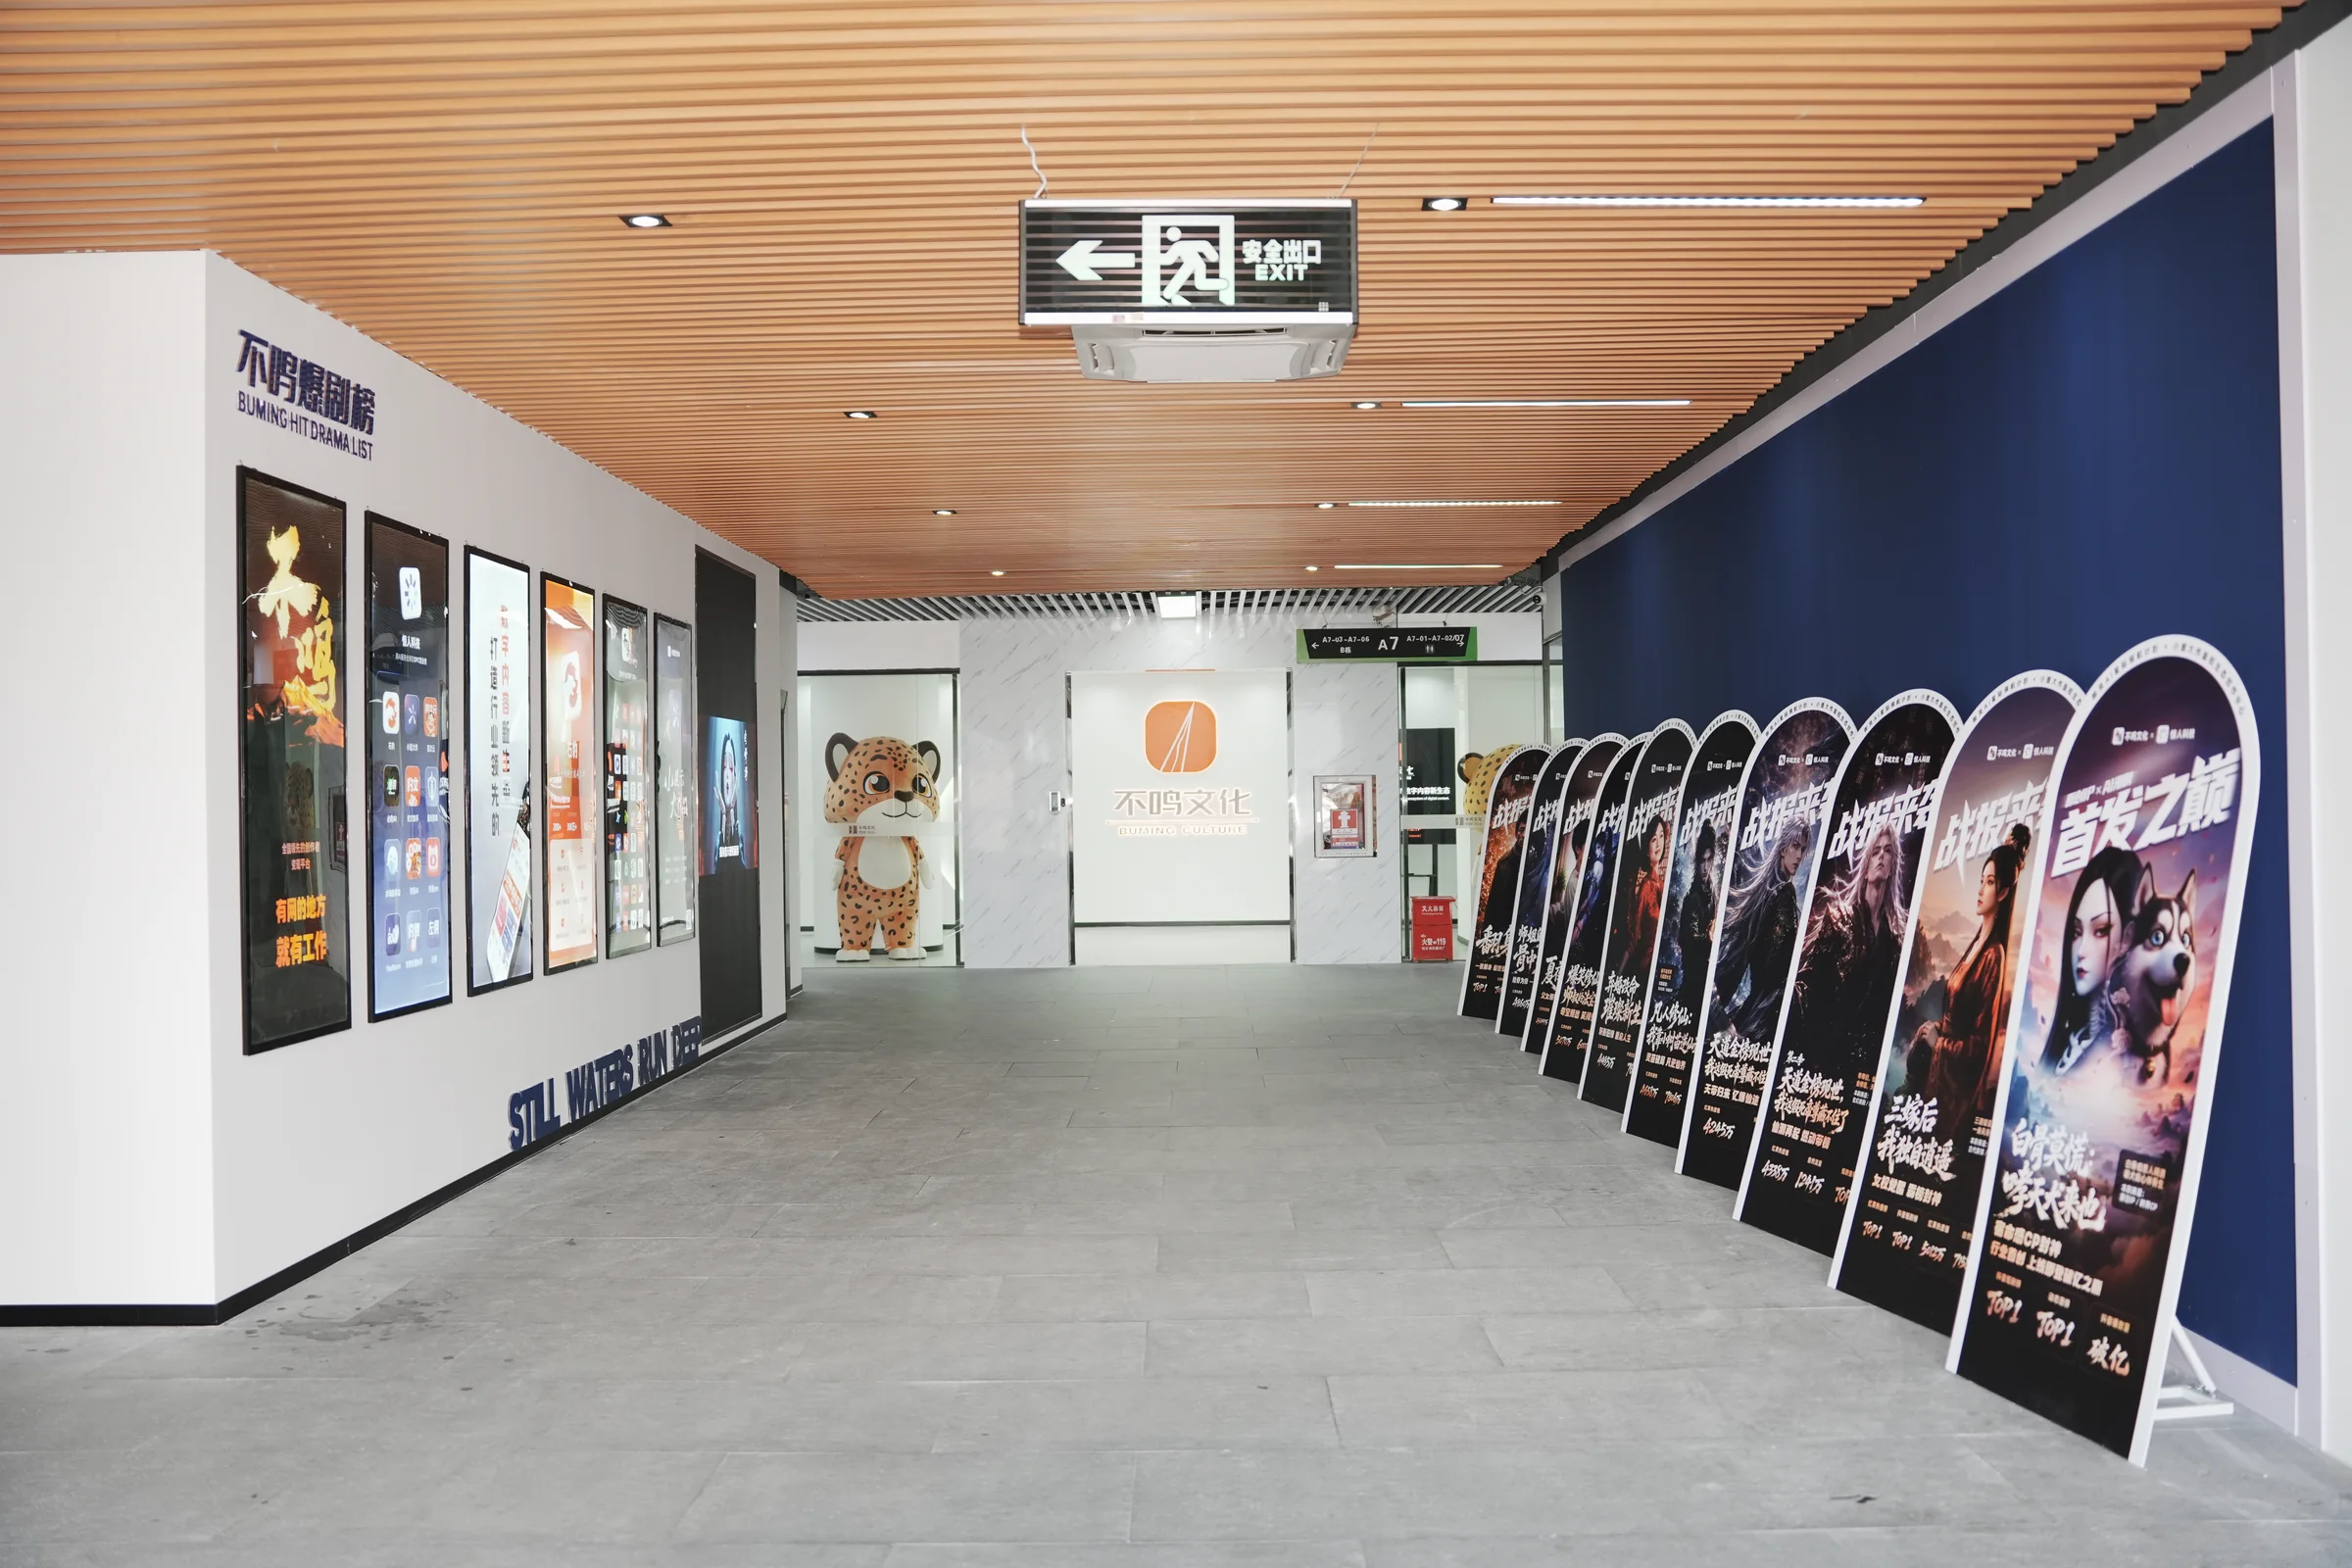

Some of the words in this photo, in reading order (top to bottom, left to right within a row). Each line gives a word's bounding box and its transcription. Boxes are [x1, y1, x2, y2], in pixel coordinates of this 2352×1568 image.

[1242, 239, 1321, 264] 安全出口
[1255, 264, 1308, 281] EXIT
[235, 329, 376, 435] 不鸣爆剧榜
[237, 390, 287, 428] BUMING
[290, 412, 309, 437] HIT
[311, 422, 350, 453] DRAMA
[352, 439, 373, 461] LIST
[1378, 636, 1398, 651] A7
[1113, 788, 1250, 816] 不鸣文化
[2050, 747, 2241, 879] 首发之巅
[1119, 826, 1175, 835] BUMING
[1182, 825, 1247, 834] CULTURE
[275, 894, 326, 924] 有网的地方
[275, 930, 327, 968] 就有工作
[508, 1077, 561, 1152] STILL
[564, 1044, 634, 1123] WATERS
[637, 1029, 668, 1087] RUN
[670, 1015, 703, 1071] DEEP
[1884, 1093, 1938, 1134] 三嫁后
[1877, 1124, 1957, 1182] 我独自逍遥
[2011, 1117, 2095, 1177] 白骨莫慌：
[1862, 1220, 1884, 1240] TOP1
[1891, 1230, 1913, 1250] TOP1
[1985, 1289, 2024, 1324] TOP1
[2035, 1310, 2076, 1348] TOP1
[2085, 1336, 2131, 1377] 破亿
